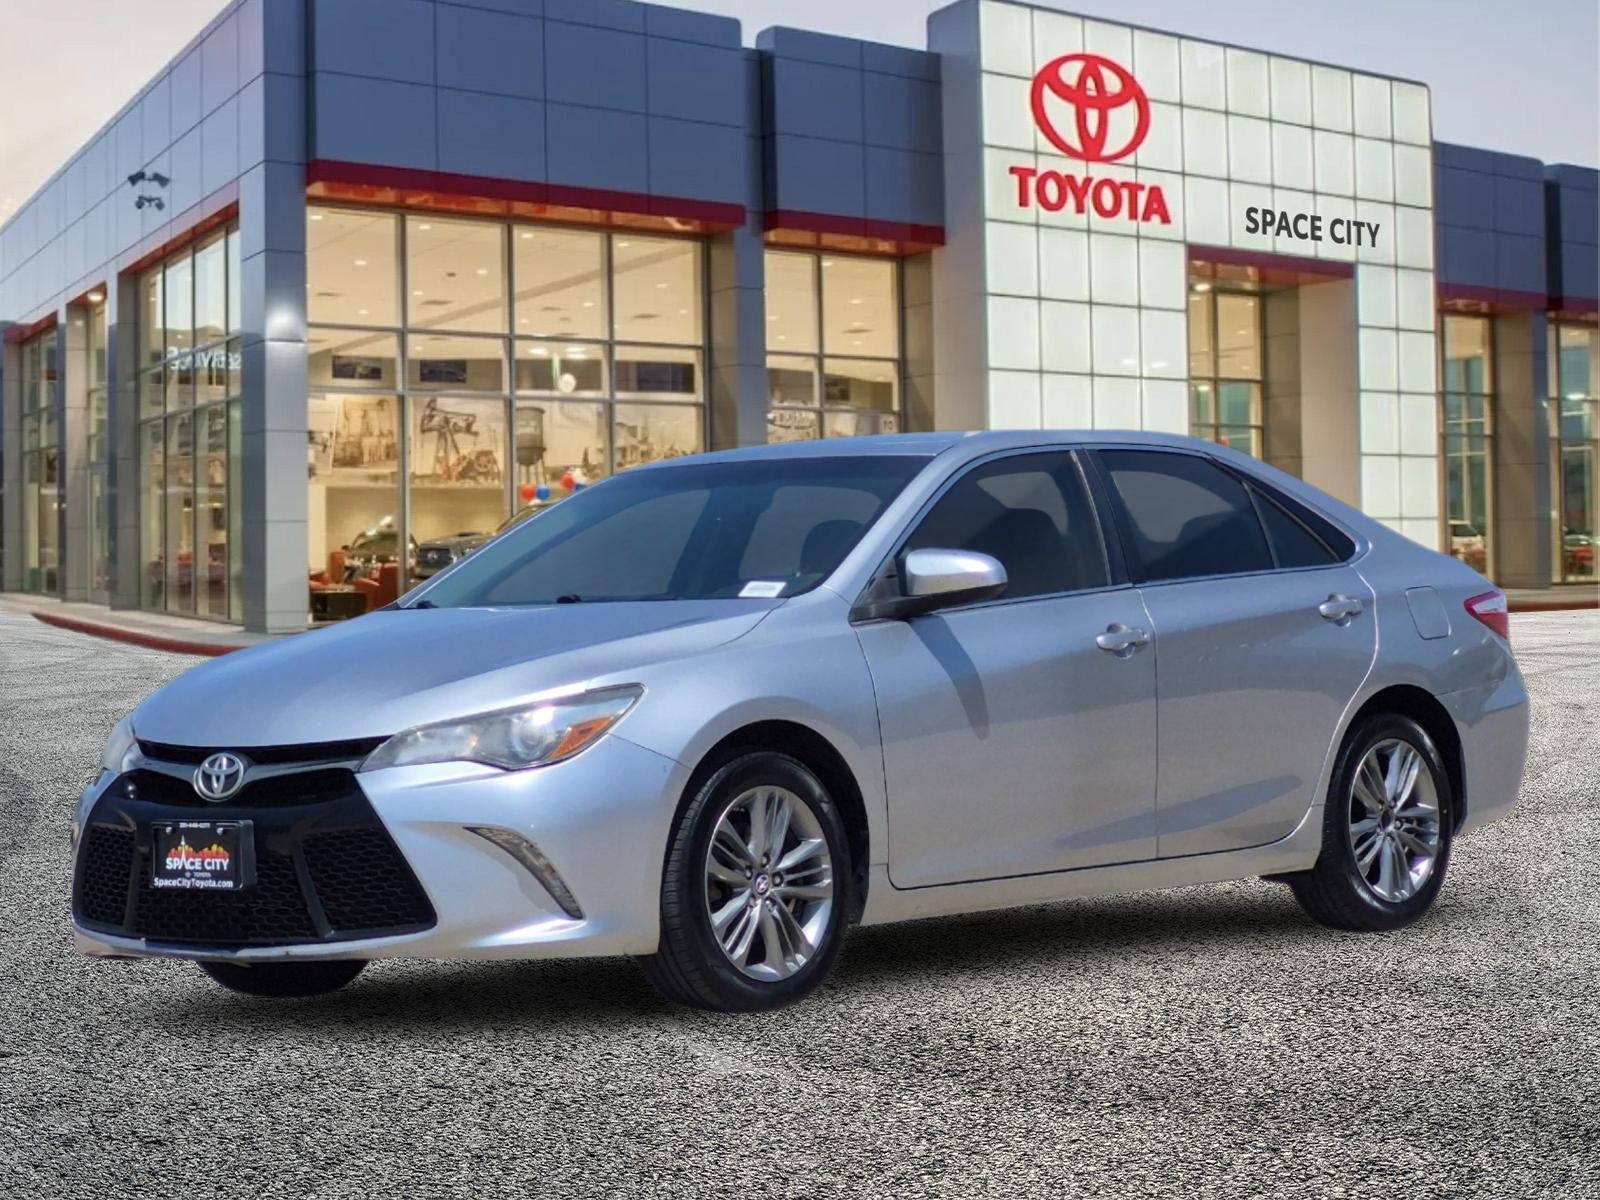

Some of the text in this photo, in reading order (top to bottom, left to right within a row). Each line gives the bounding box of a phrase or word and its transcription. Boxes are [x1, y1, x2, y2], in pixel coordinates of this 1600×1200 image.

[1009, 166, 1171, 224] TOYOTA
[1245, 207, 1381, 248] SPACE CITY
[165, 857, 229, 870] SPACE CITY
[153, 877, 234, 889] SpaceCityToyota.com
